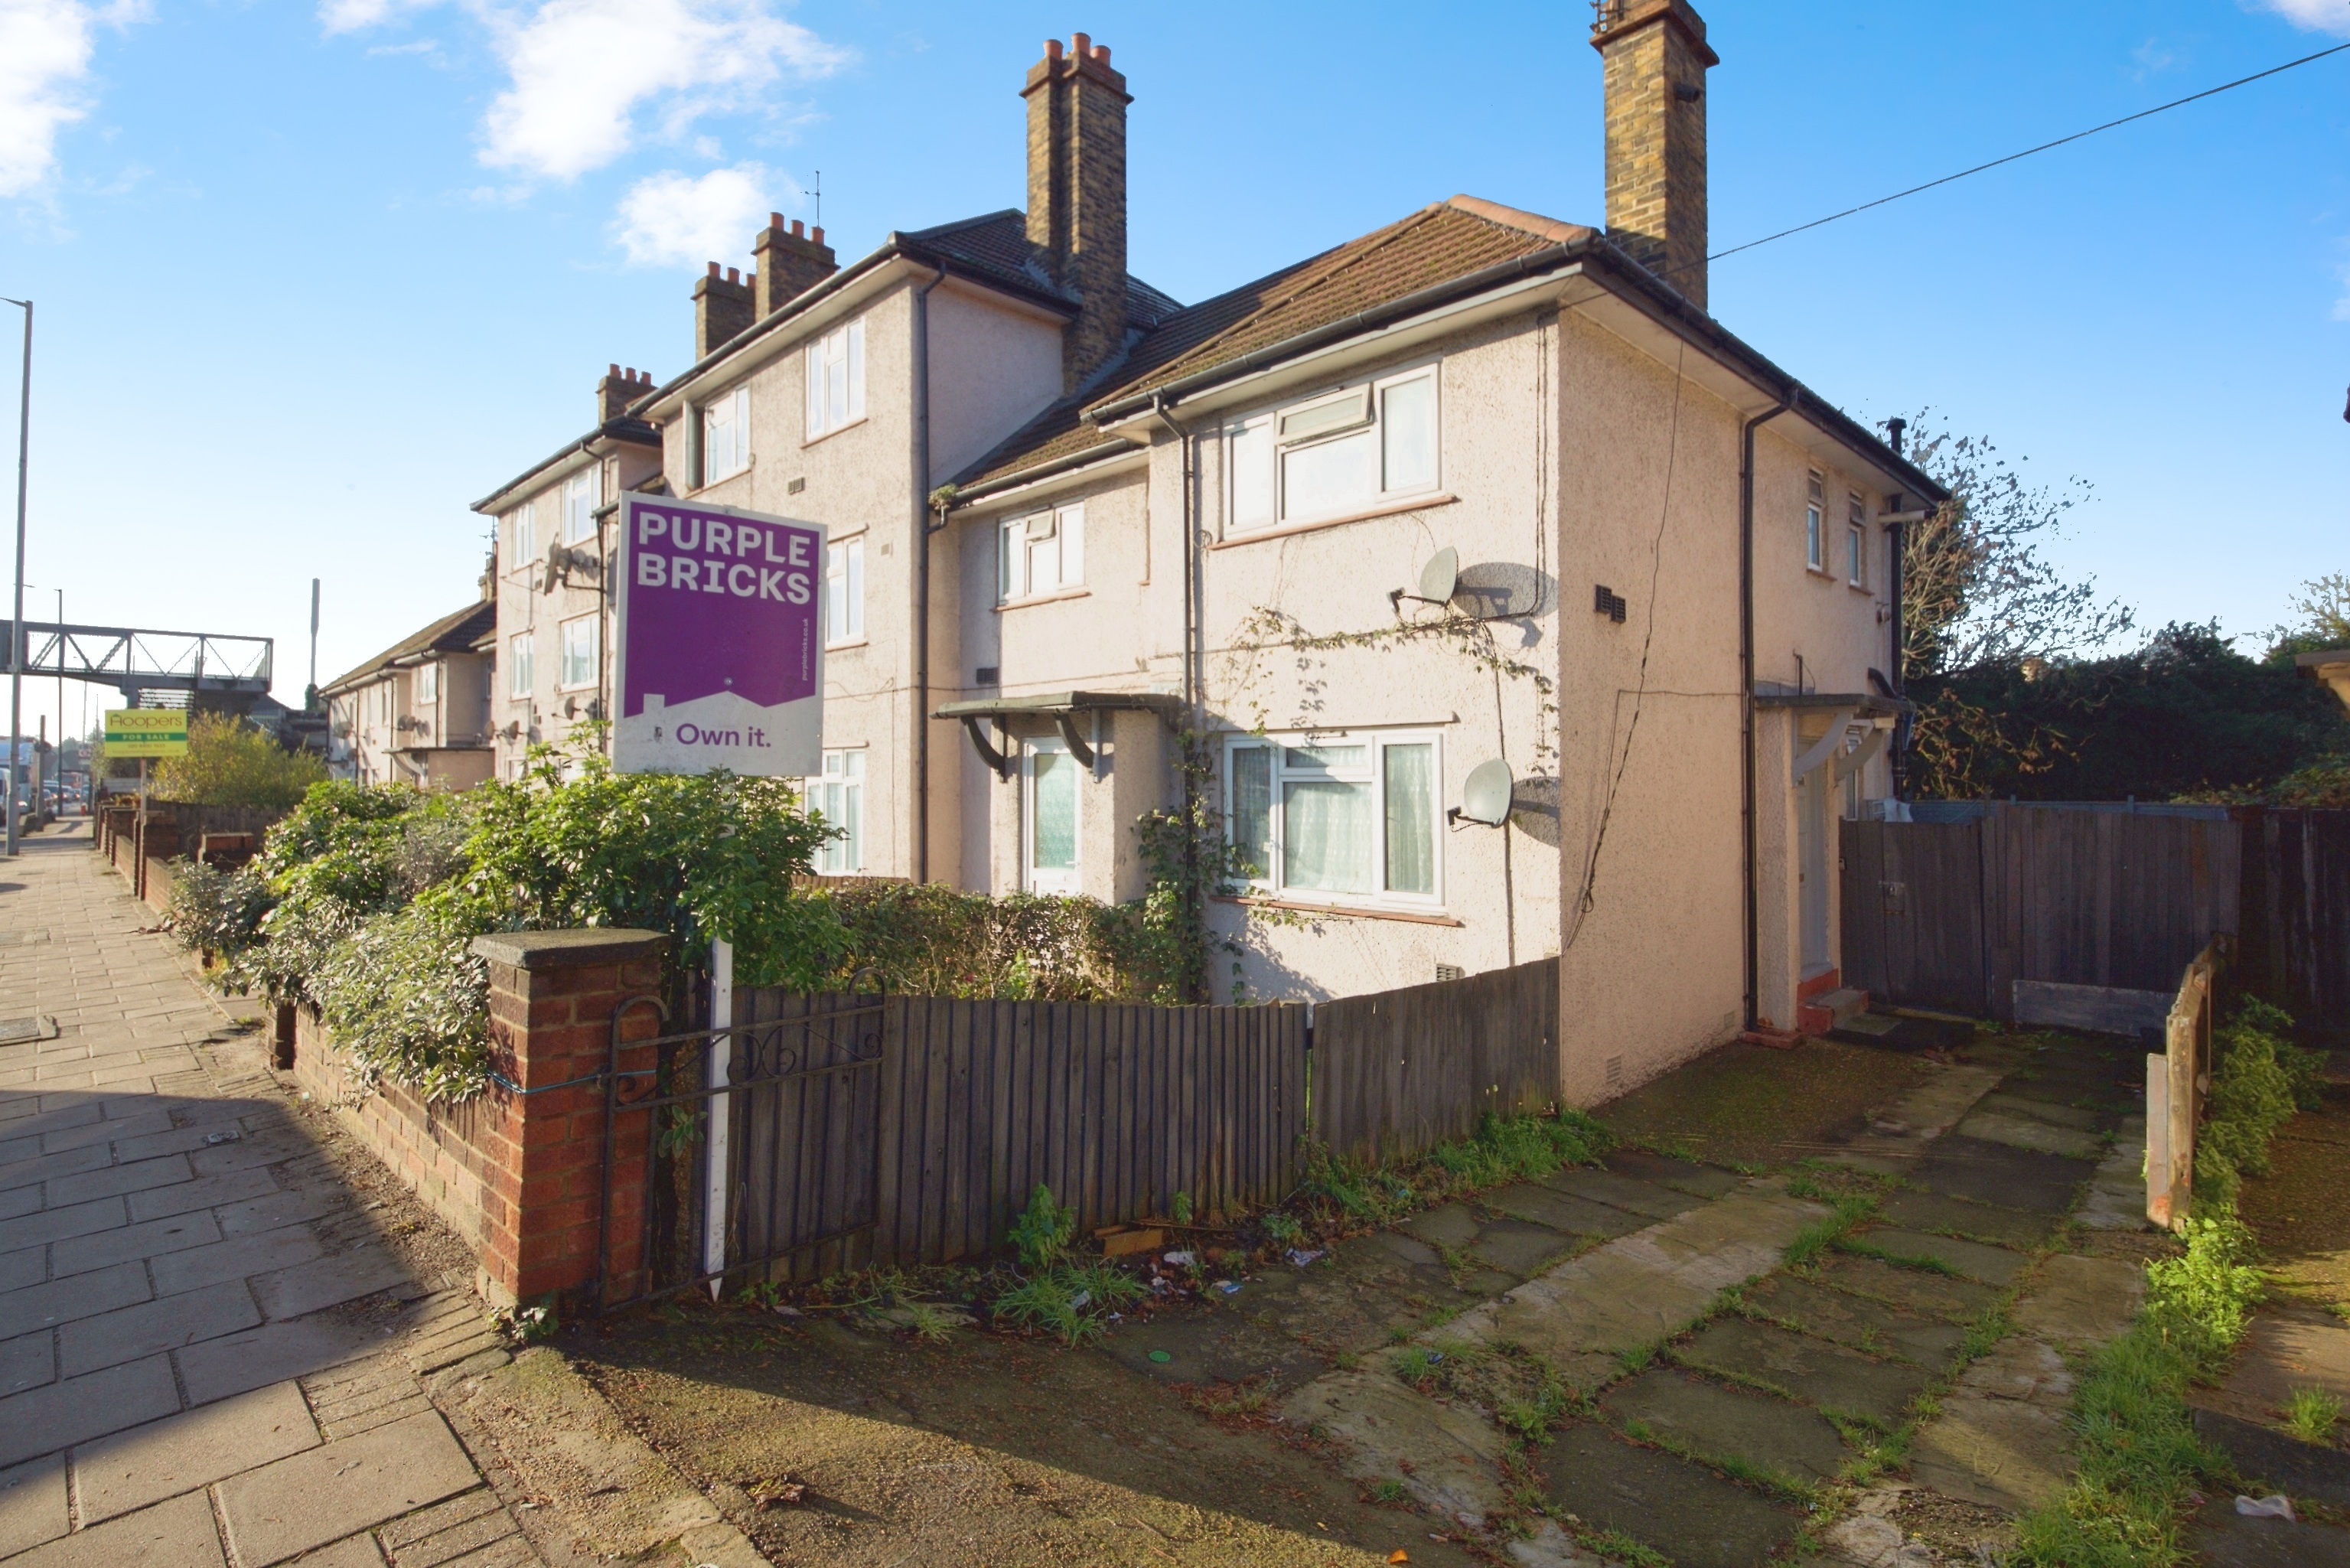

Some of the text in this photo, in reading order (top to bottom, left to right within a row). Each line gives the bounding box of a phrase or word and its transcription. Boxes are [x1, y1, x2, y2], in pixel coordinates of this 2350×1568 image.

[638, 511, 810, 568] PURPLE
[637, 552, 810, 605] BRICKS
[109, 715, 182, 729] Hoopers
[676, 723, 771, 748] Own it.
